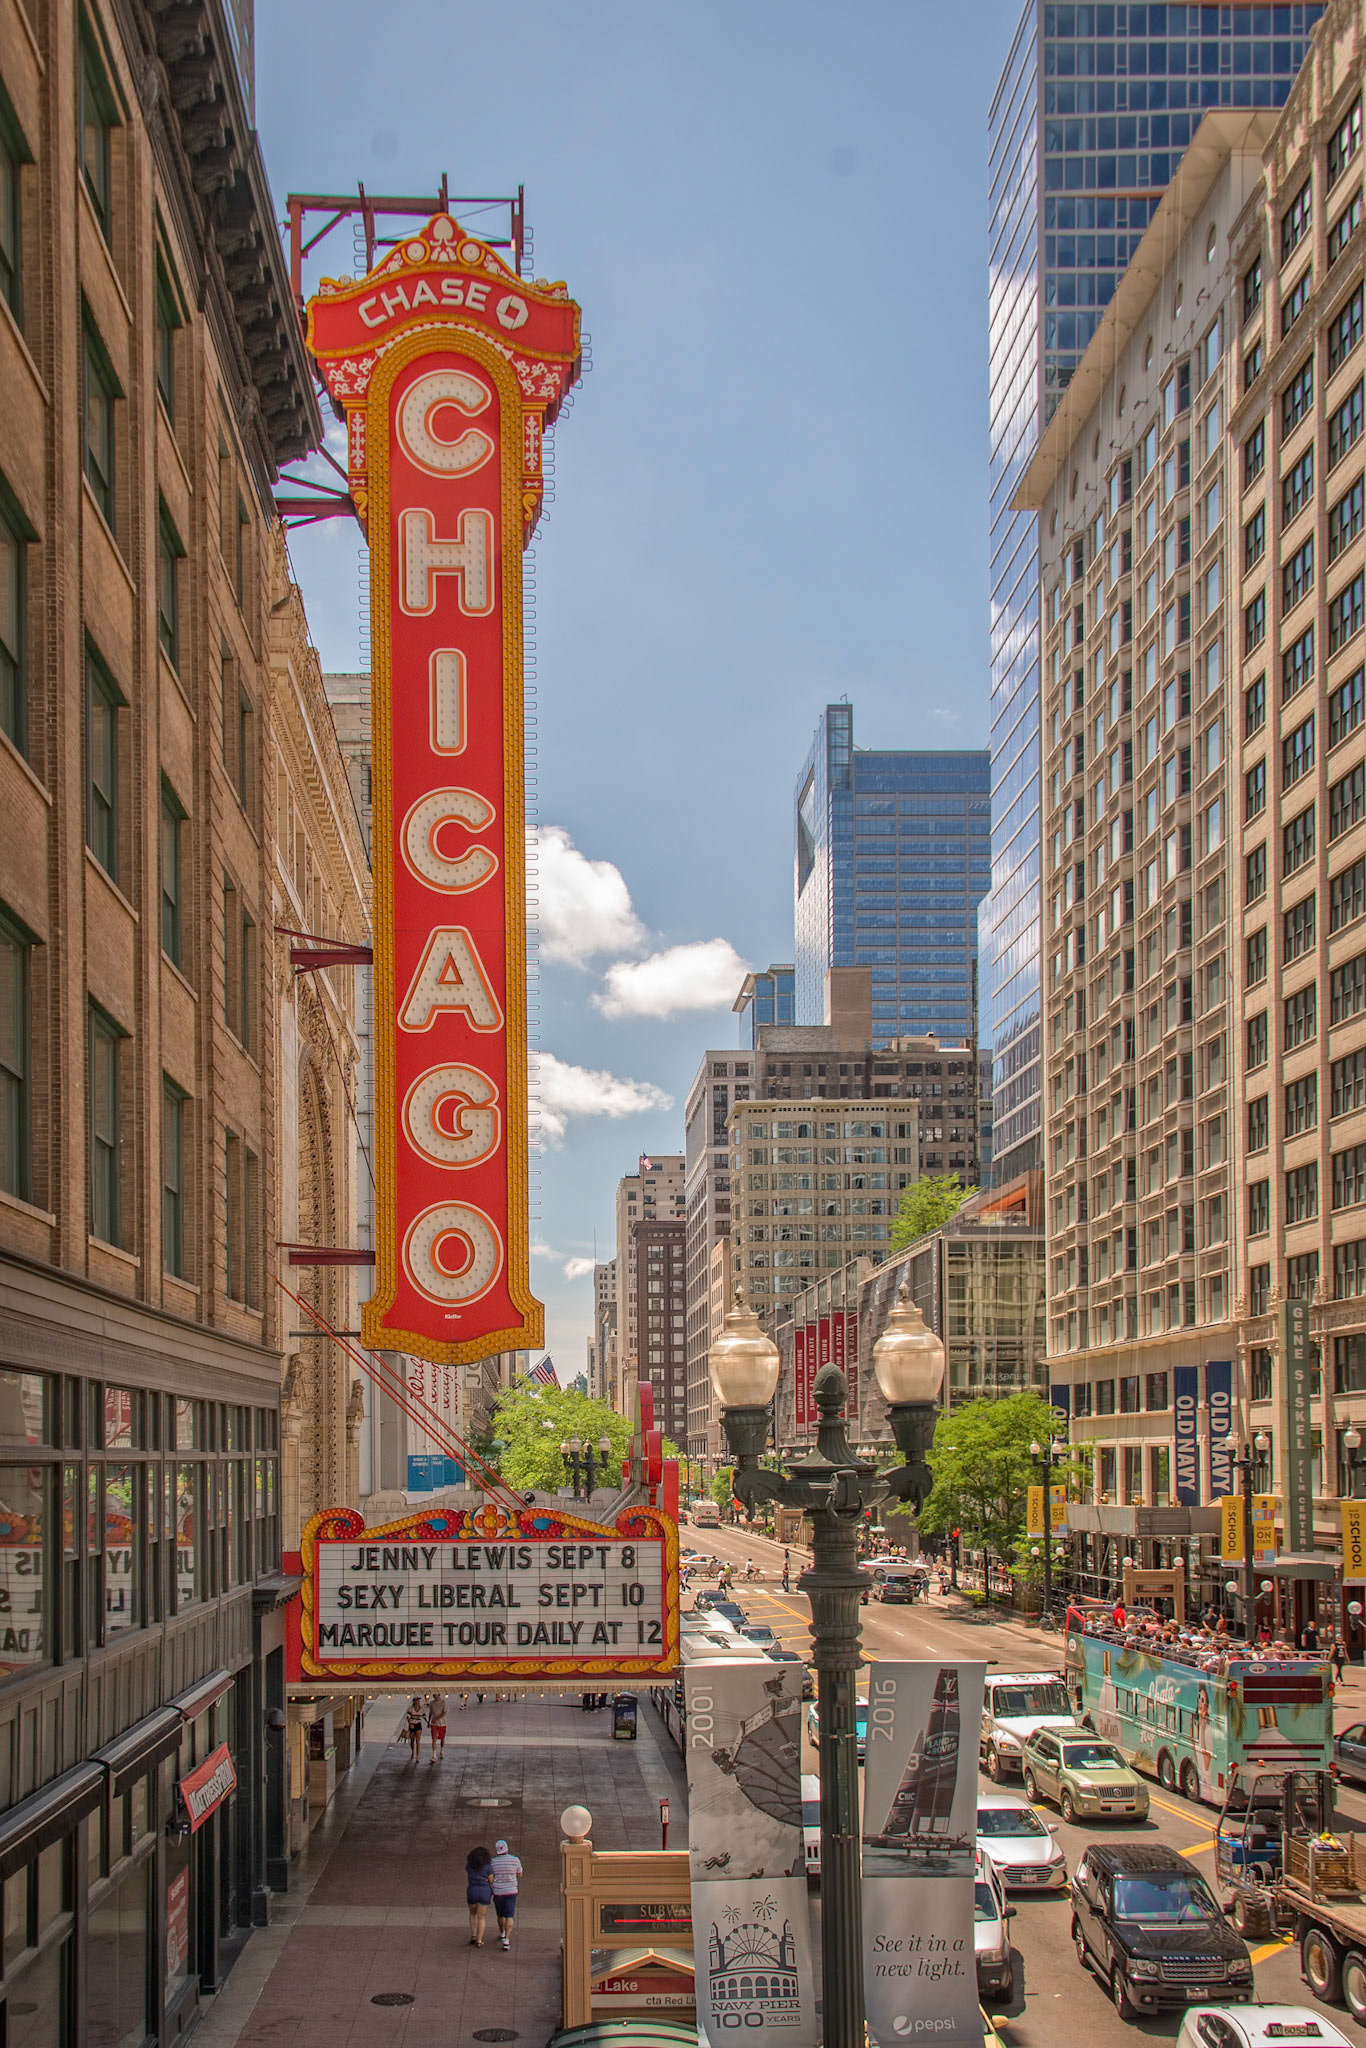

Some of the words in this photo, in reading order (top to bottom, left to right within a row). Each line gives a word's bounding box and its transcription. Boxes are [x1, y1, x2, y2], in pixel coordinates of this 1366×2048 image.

[357, 279, 492, 329] CHASE
[395, 368, 506, 1309] CHICAGO
[1292, 1307, 1304, 1360] GENE
[1176, 1395, 1195, 1434] OLD
[1210, 1391, 1230, 1432] OLD
[1294, 1369, 1305, 1450] SISKEL
[1177, 1438, 1196, 1491] NAVY
[1211, 1436, 1231, 1492] NAVY
[1298, 1459, 1306, 1491] FILM
[1031, 1498, 1039, 1528] SCHOOL
[1298, 1496, 1306, 1545] CENTER
[1228, 1512, 1237, 1553] SCHOOL
[1257, 1531, 1271, 1539] ON
[1350, 1520, 1362, 1570] SCHOOL
[351, 1546, 438, 1571] JENNY
[452, 1545, 534, 1570] LEWIS
[546, 1545, 611, 1569] SEPT
[621, 1544, 636, 1569] 8
[337, 1584, 404, 1609] SEXY
[418, 1583, 521, 1608] LIBERAL
[538, 1582, 604, 1607] SEPT
[319, 1621, 434, 1647] MARQUEE
[443, 1621, 507, 1646] TOUR
[516, 1620, 584, 1646] DAILY
[591, 1620, 623, 1645] AT
[637, 1619, 662, 1644] 12
[691, 1685, 714, 1749] 2001
[871, 1679, 897, 1742] 2016
[929, 1736, 950, 1749] LAND
[930, 1742, 958, 1754] ROVER
[873, 1934, 903, 1952] See
[907, 1934, 922, 1952] it
[927, 1934, 948, 1952] in
[952, 1938, 965, 1952] a
[874, 1964, 912, 1977] new
[916, 1957, 965, 1982] light.
[604, 1979, 639, 1992] Lake
[646, 1997, 662, 2005] cta
[664, 1996, 683, 2005] Red
[711, 2002, 754, 2011] NAVY
[758, 2000, 801, 2010] PIER
[711, 2012, 764, 2029] 100
[915, 2016, 957, 2033] pepsi
